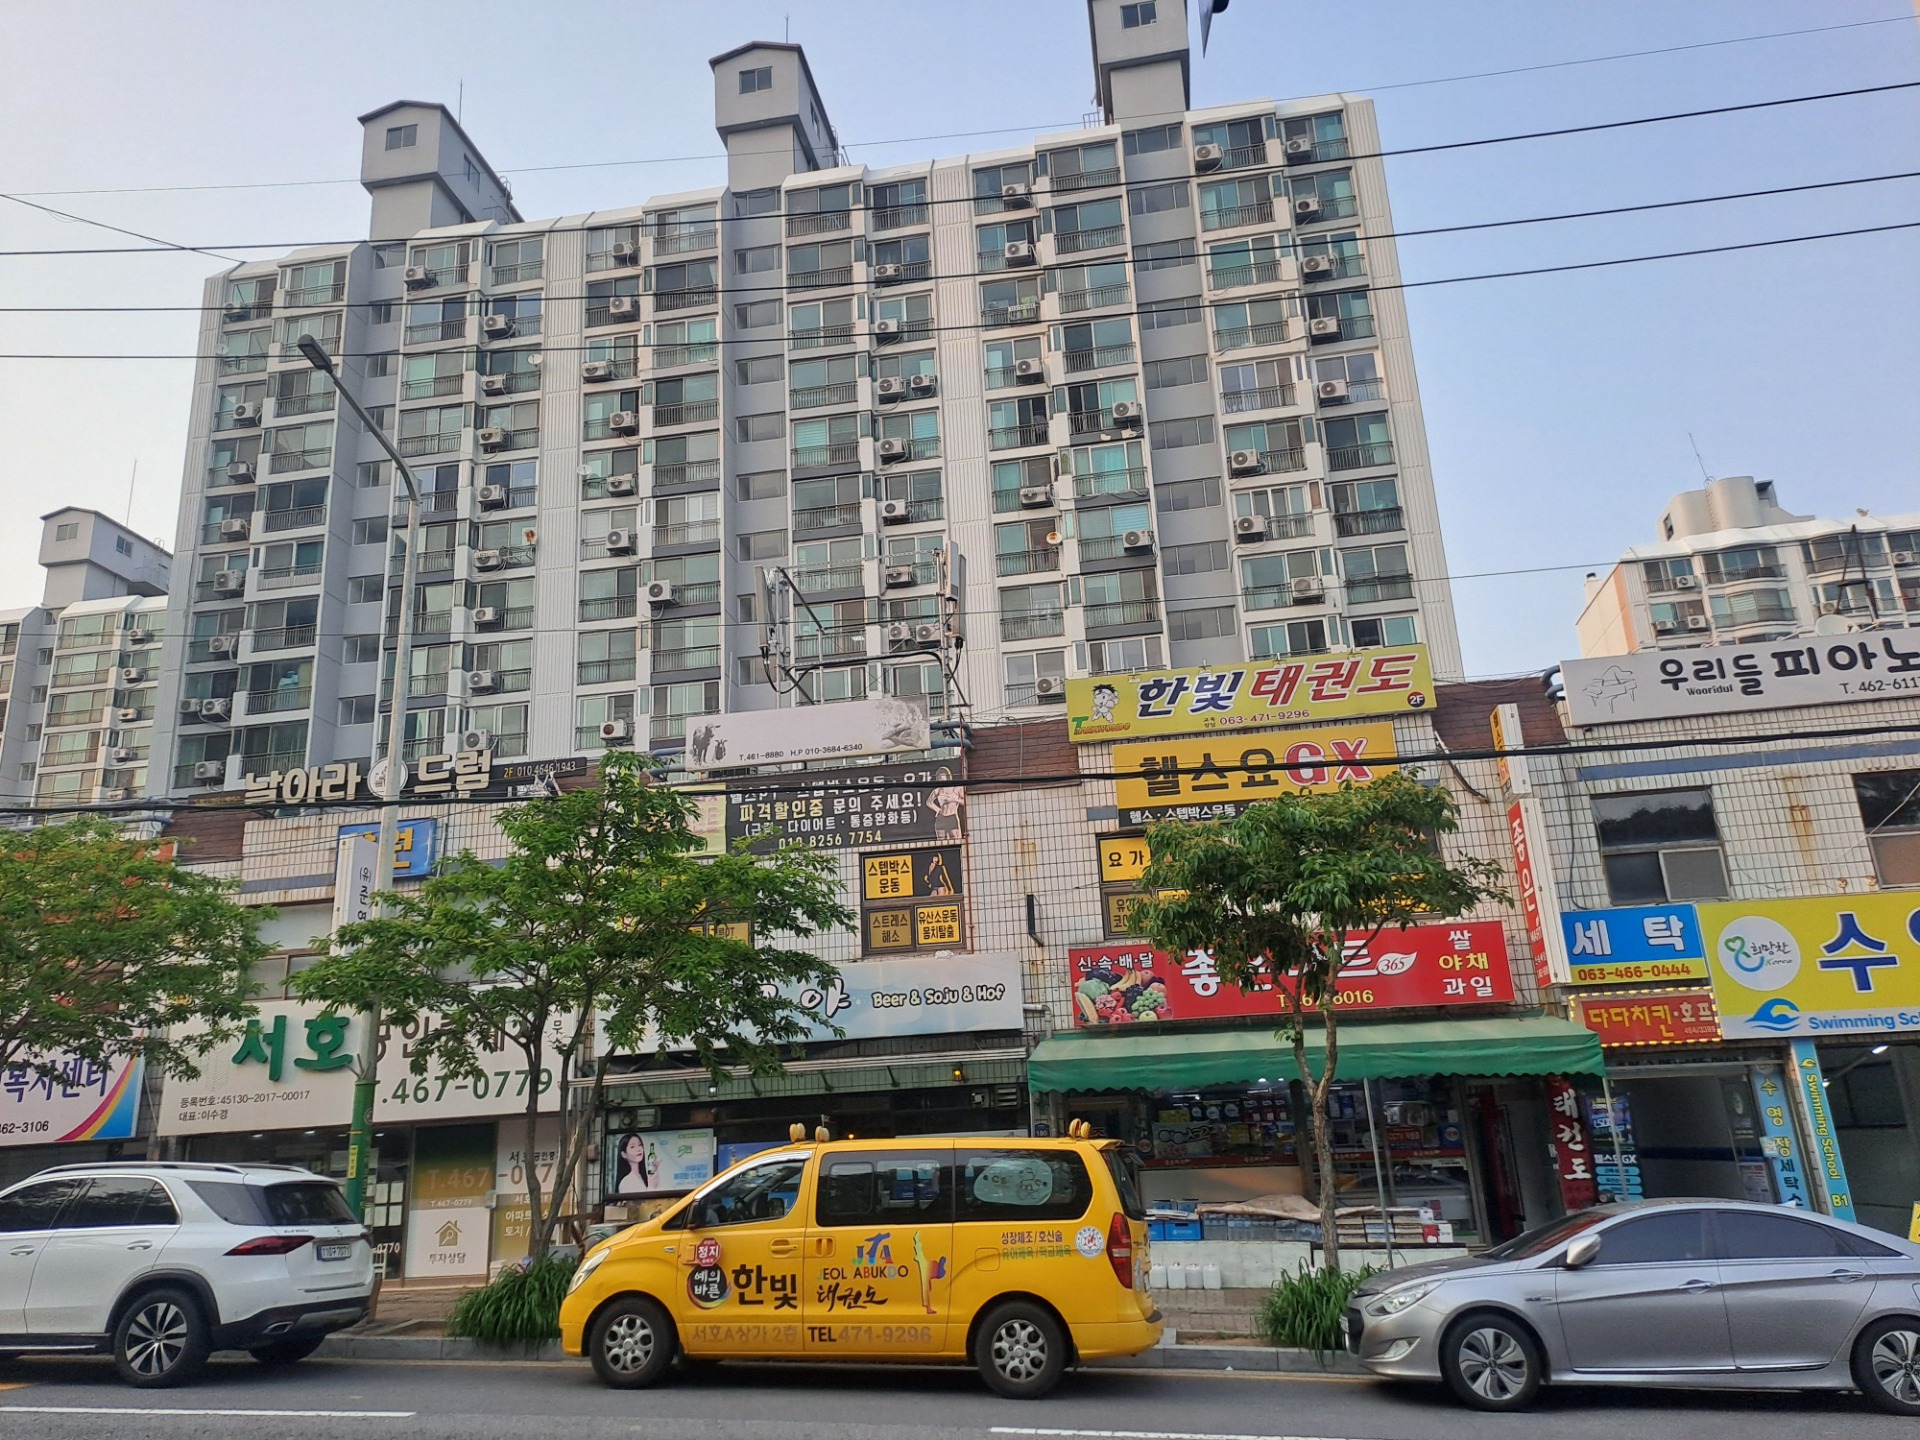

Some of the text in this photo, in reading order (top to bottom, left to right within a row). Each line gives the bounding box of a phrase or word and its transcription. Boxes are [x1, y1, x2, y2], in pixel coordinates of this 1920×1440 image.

[1659, 637, 1920, 697] 우리들 피아노
[1138, 655, 1418, 718] 한빛 태권도
[1686, 684, 1734, 697] Wooridul
[1839, 682, 1855, 695] T.
[1409, 694, 1424, 706] 2F
[1219, 710, 1310, 726] 063-471-9296
[739, 750, 784, 762] T.461-8880
[805, 743, 863, 756] 010-3684-6340
[244, 749, 492, 805] 날아라 드럼
[503, 766, 514, 778] 2F
[740, 798, 824, 822] 파격할인중
[833, 796, 861, 814] 문의
[870, 791, 922, 811] 주세요!
[787, 815, 836, 833] 다이어트
[850, 809, 918, 829] 통증완화등)
[1129, 810, 1154, 824] 헬스
[809, 832, 842, 847] 8256
[849, 829, 882, 845] 7754
[868, 858, 910, 877] 스텝박스
[1108, 850, 1145, 868] 요가
[879, 877, 900, 895] 운동
[872, 913, 909, 929] 스트레스
[918, 908, 958, 926] 유산소운동
[881, 929, 900, 944] 해소
[1447, 929, 1473, 951] 쌀
[1750, 940, 1792, 957] 희망찬
[1381, 956, 1409, 973] 365
[1438, 952, 1489, 971] 야채
[1577, 963, 1692, 981] 063-466-0444
[871, 983, 1006, 1008] Beer & Soju & Hof
[1442, 976, 1494, 997] 과일
[1808, 1011, 1920, 1030] Swimming Sc
[231, 1014, 354, 1082] 서호
[1806, 1074, 1842, 1180] Swimming School
[1831, 1194, 1849, 1207] B1
[429, 1252, 466, 1265] 투자상담
[698, 1245, 719, 1259] 정지
[694, 1269, 720, 1284] 예의
[694, 1283, 720, 1299] 바른
[731, 1263, 798, 1311] 한빛
[816, 1281, 889, 1313] 태권도
[807, 1325, 933, 1344] TEL 471-9296
